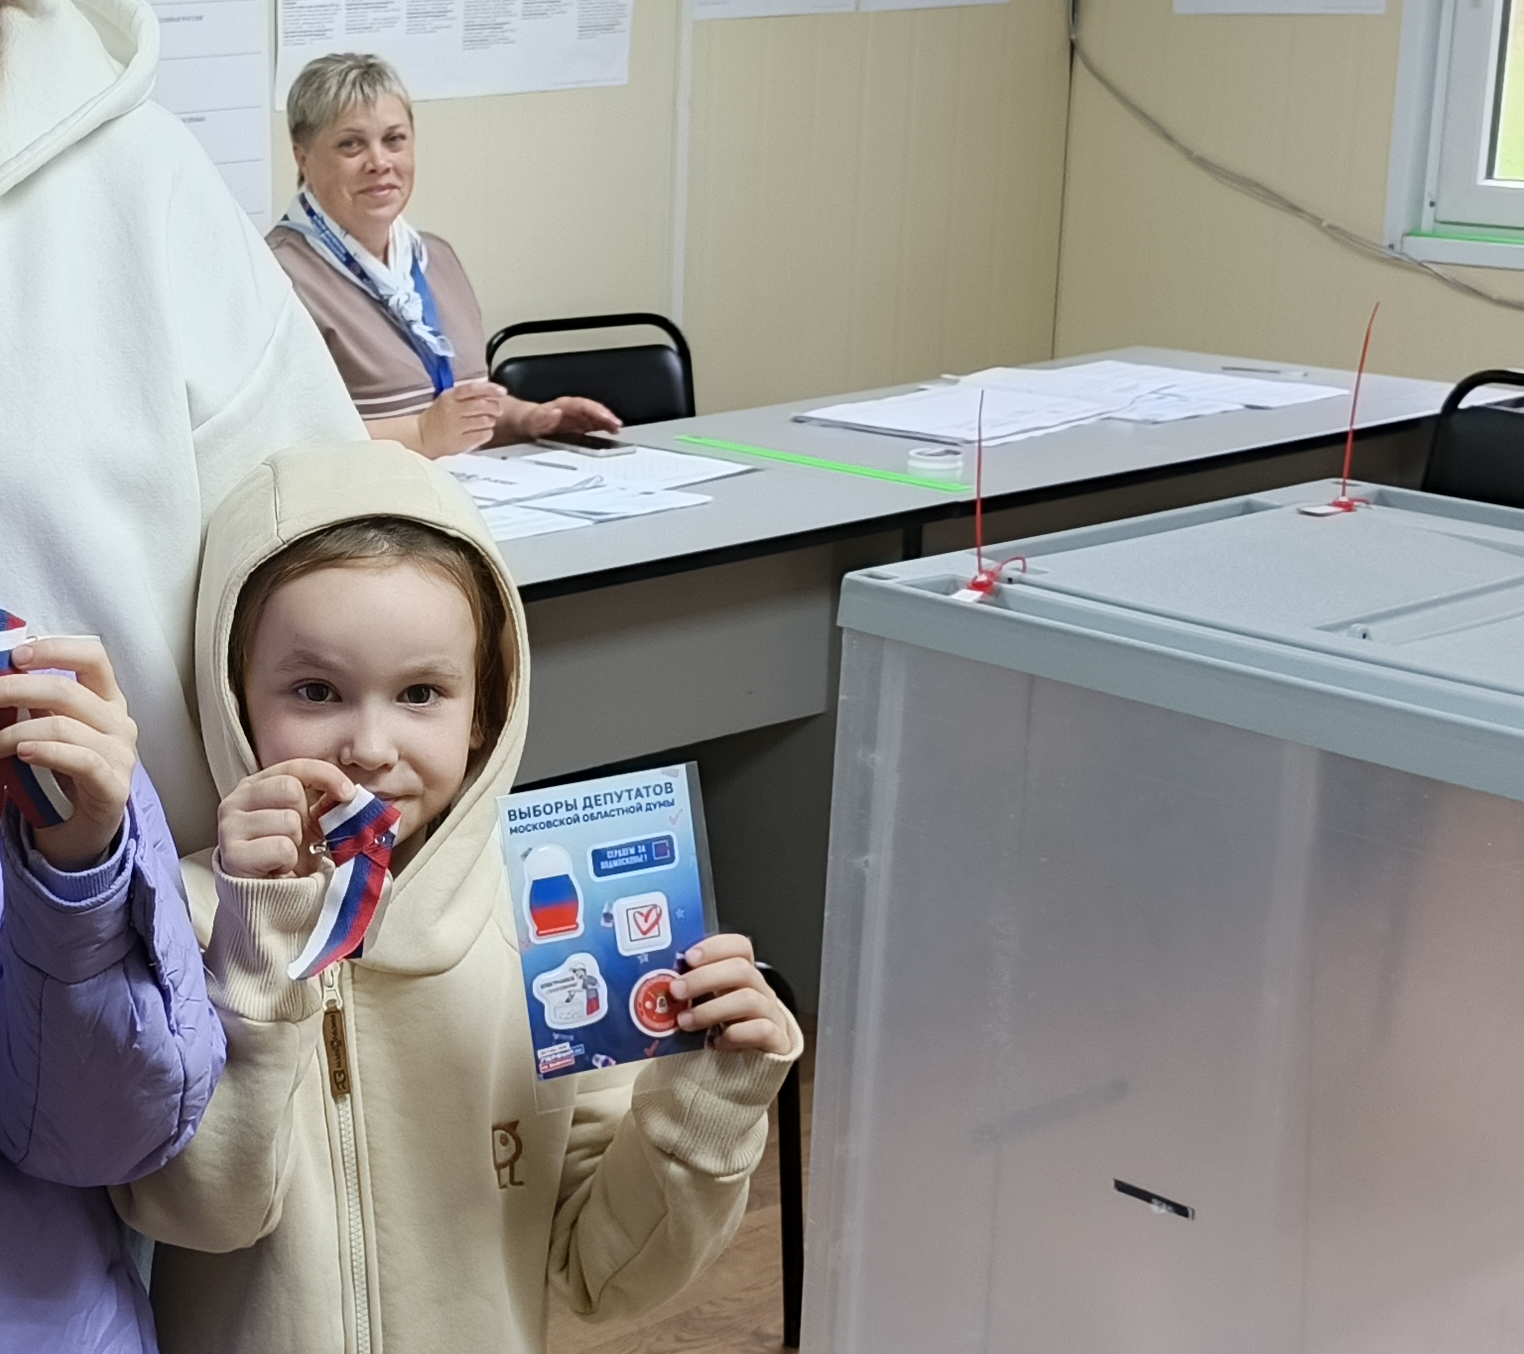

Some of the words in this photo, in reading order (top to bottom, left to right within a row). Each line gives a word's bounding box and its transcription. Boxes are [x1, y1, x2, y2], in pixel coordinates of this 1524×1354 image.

[507, 799, 577, 822] ВЫБОРЫ
[582, 782, 674, 811] ДЕПУТАТОВ
[509, 814, 580, 835] МОСКОВСКОЙ
[582, 802, 643, 822] ОБЛАСТНОЙ
[645, 798, 675, 812] ДУМЫ
